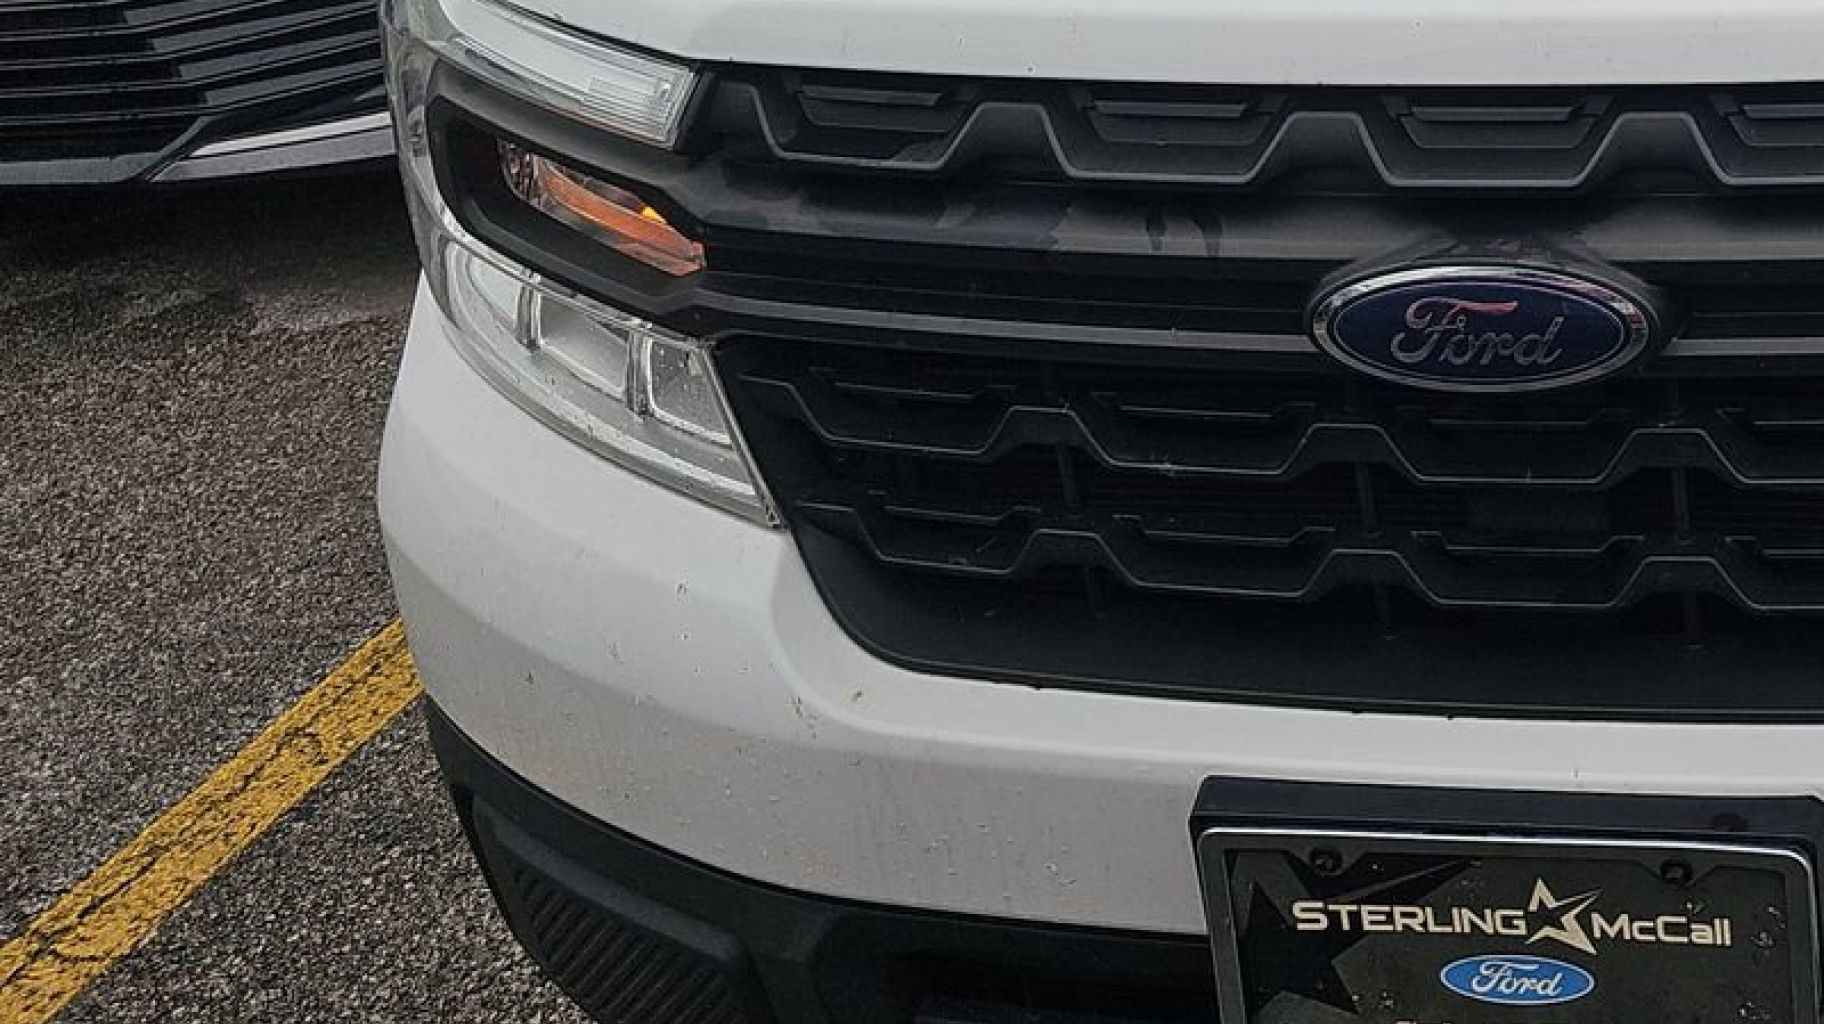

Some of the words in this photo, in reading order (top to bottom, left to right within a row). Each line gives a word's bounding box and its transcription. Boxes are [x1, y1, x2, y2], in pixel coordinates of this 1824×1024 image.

[1391, 296, 1565, 366] Ford
[1292, 901, 1527, 936] STERLING
[1590, 912, 1731, 947] McCall
[1472, 961, 1562, 996] Ford
